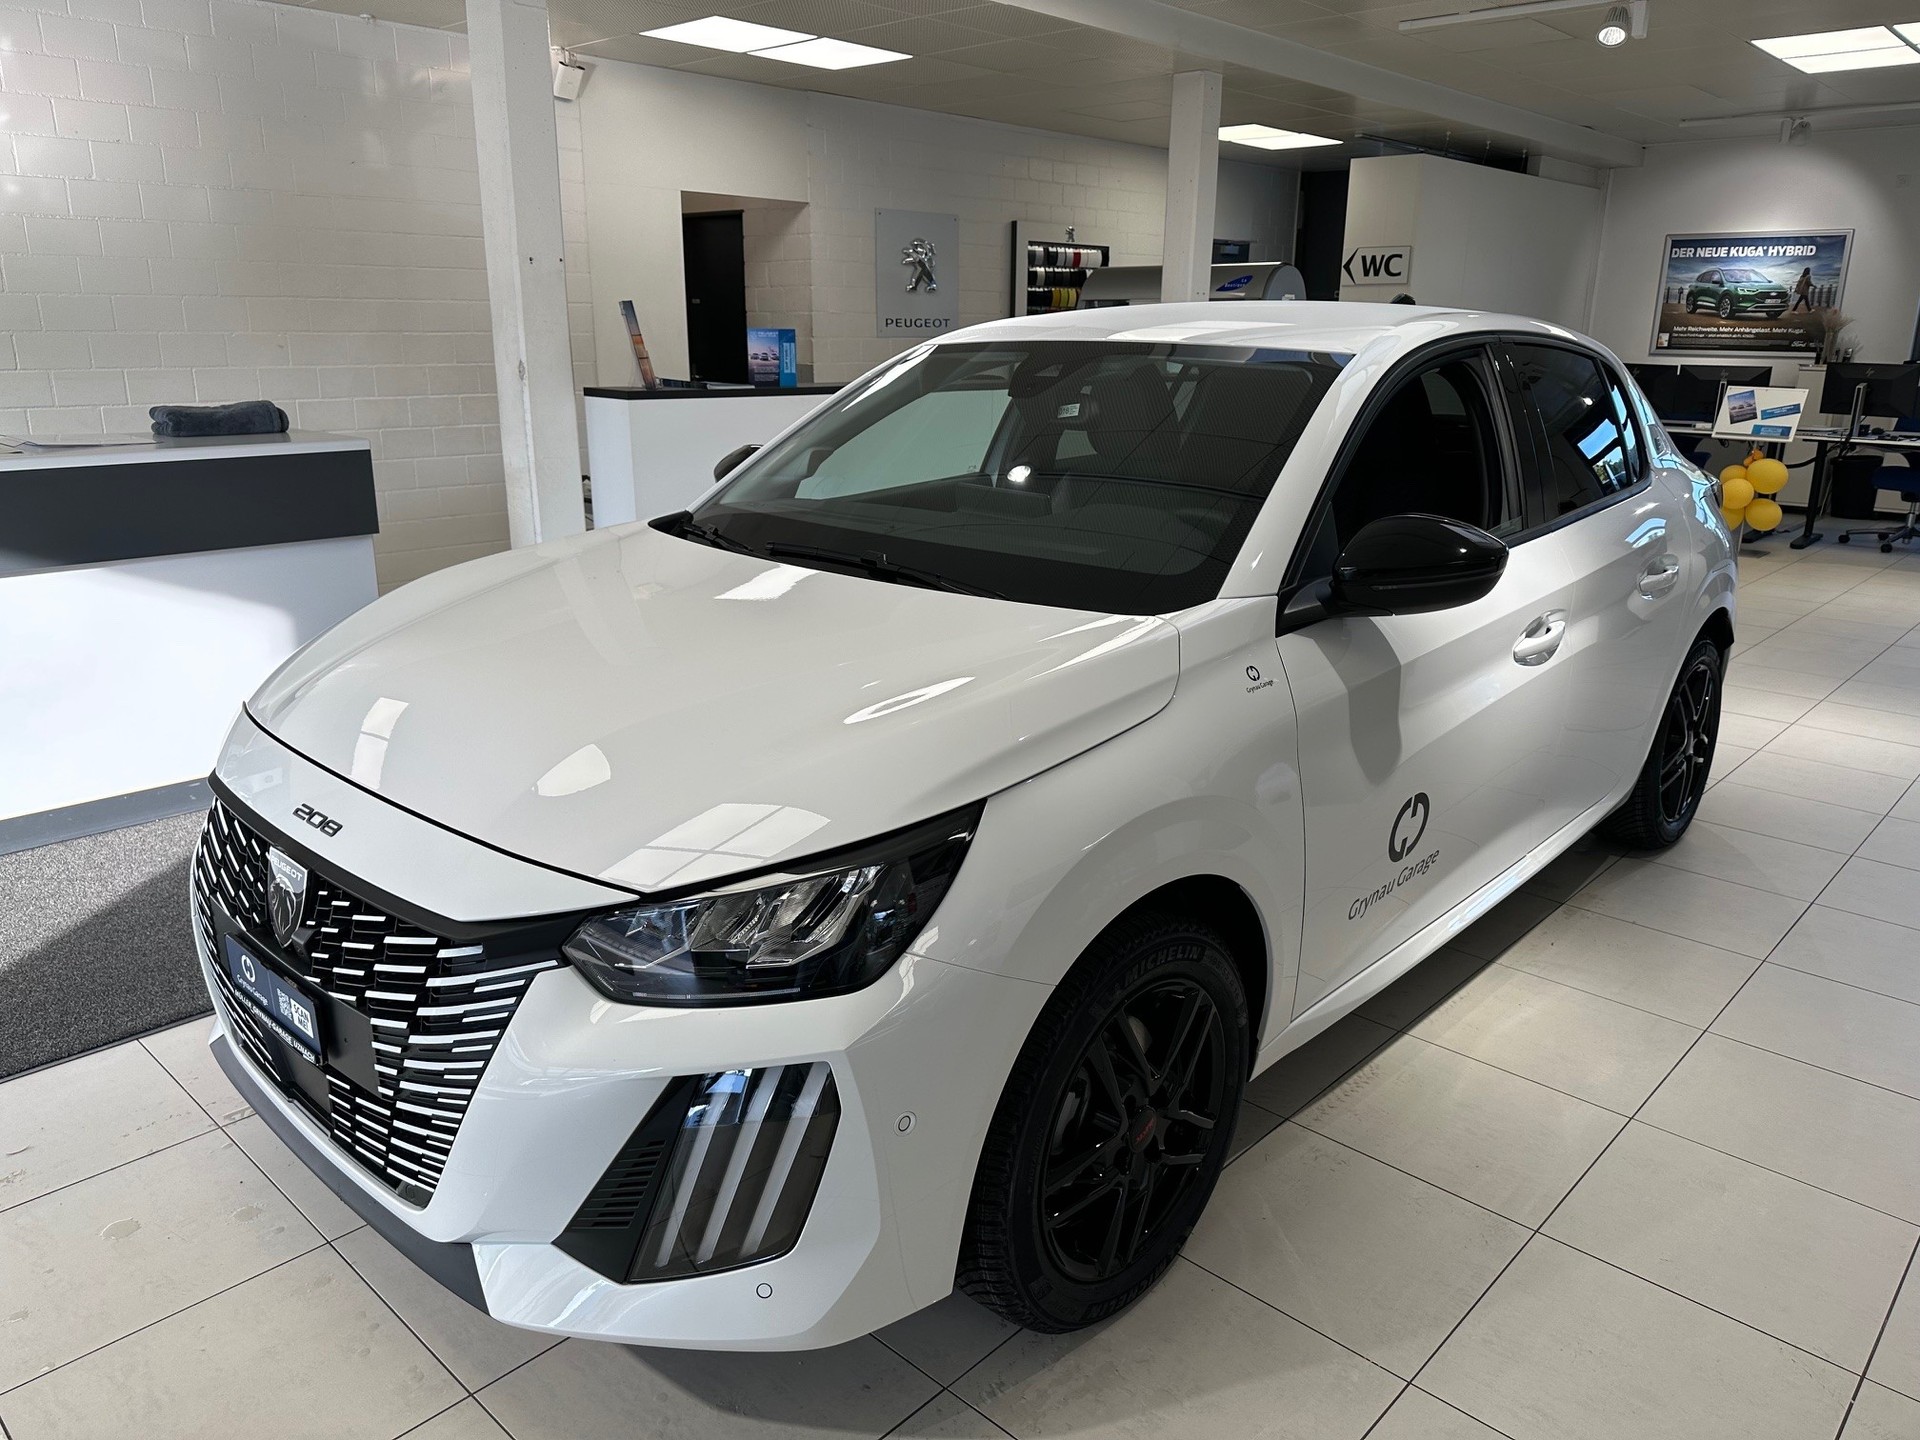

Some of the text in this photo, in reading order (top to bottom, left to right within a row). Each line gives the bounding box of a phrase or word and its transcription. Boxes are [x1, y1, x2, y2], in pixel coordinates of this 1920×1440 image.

[1671, 247, 1695, 258] DER
[1696, 246, 1729, 258] NEUE
[1767, 245, 1817, 257] HYBRID
[1361, 253, 1403, 277] WC
[885, 318, 950, 328] PEUGEOT
[292, 803, 343, 838] 208
[271, 855, 303, 881] PEUGEOT
[1348, 850, 1440, 920] Grynau Garage
[1126, 944, 1202, 985] MICHELIN
